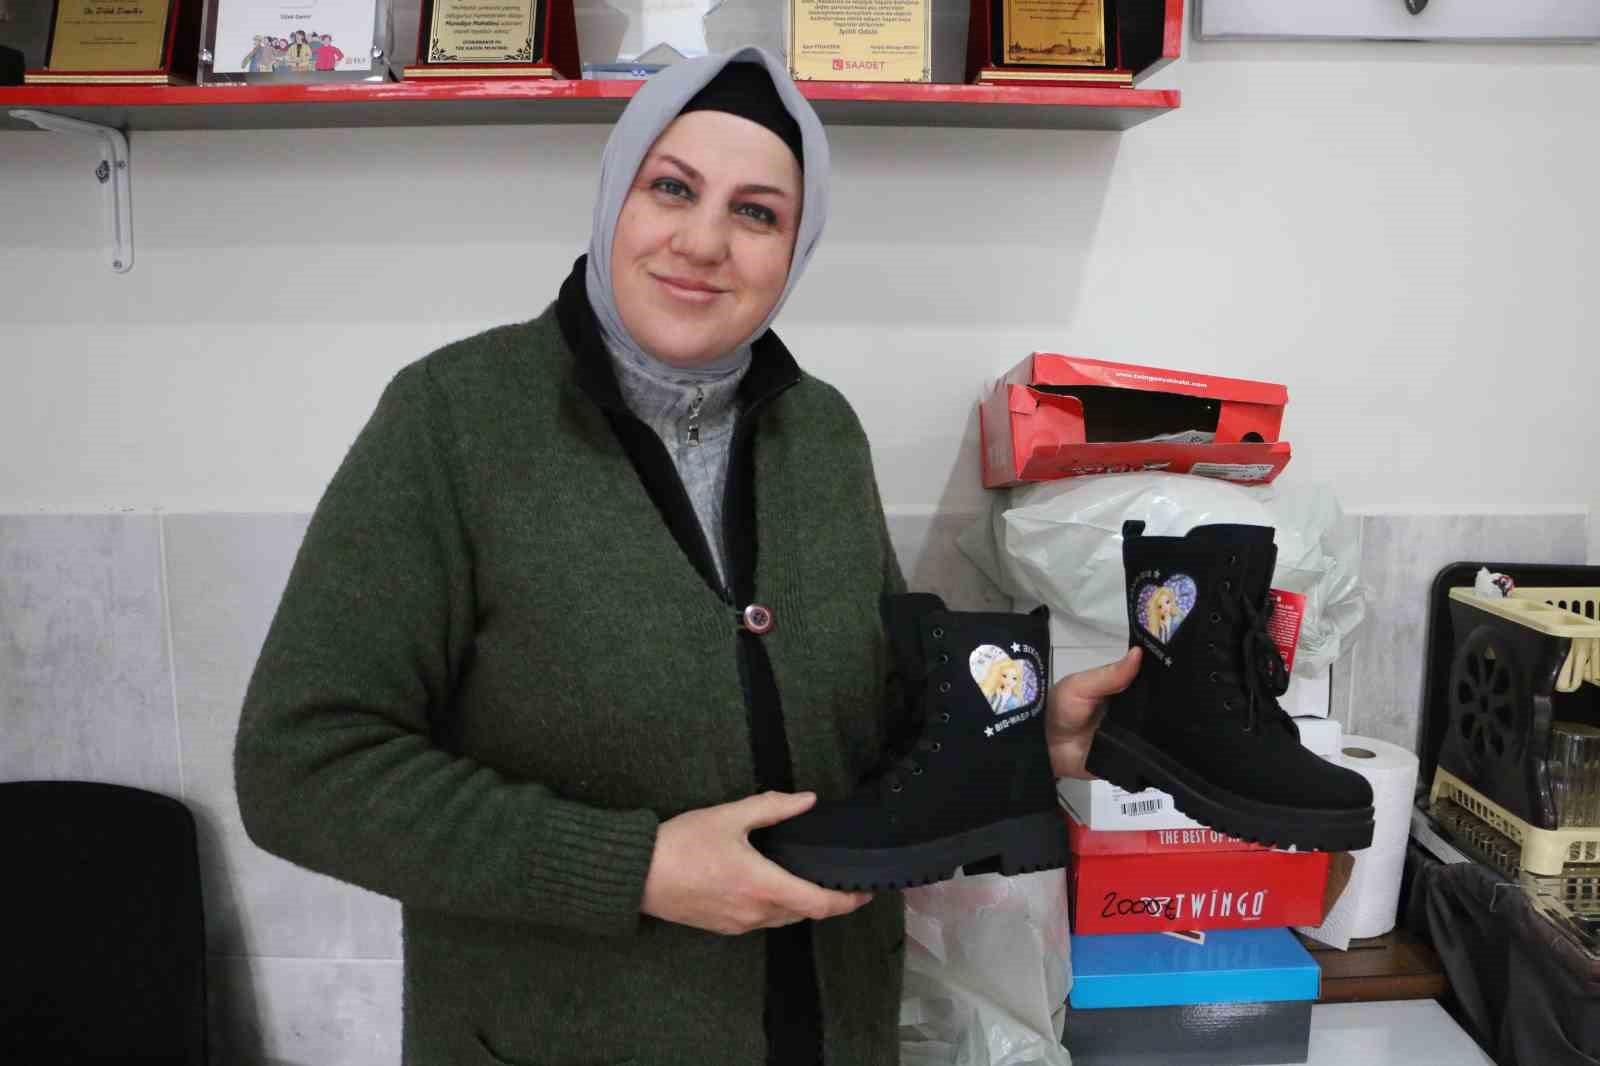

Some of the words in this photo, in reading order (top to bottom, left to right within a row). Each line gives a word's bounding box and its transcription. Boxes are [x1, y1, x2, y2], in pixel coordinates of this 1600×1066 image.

[845, 61, 885, 70] SAADET
[1160, 830, 1179, 845] THE
[1182, 830, 1207, 844] BEST
